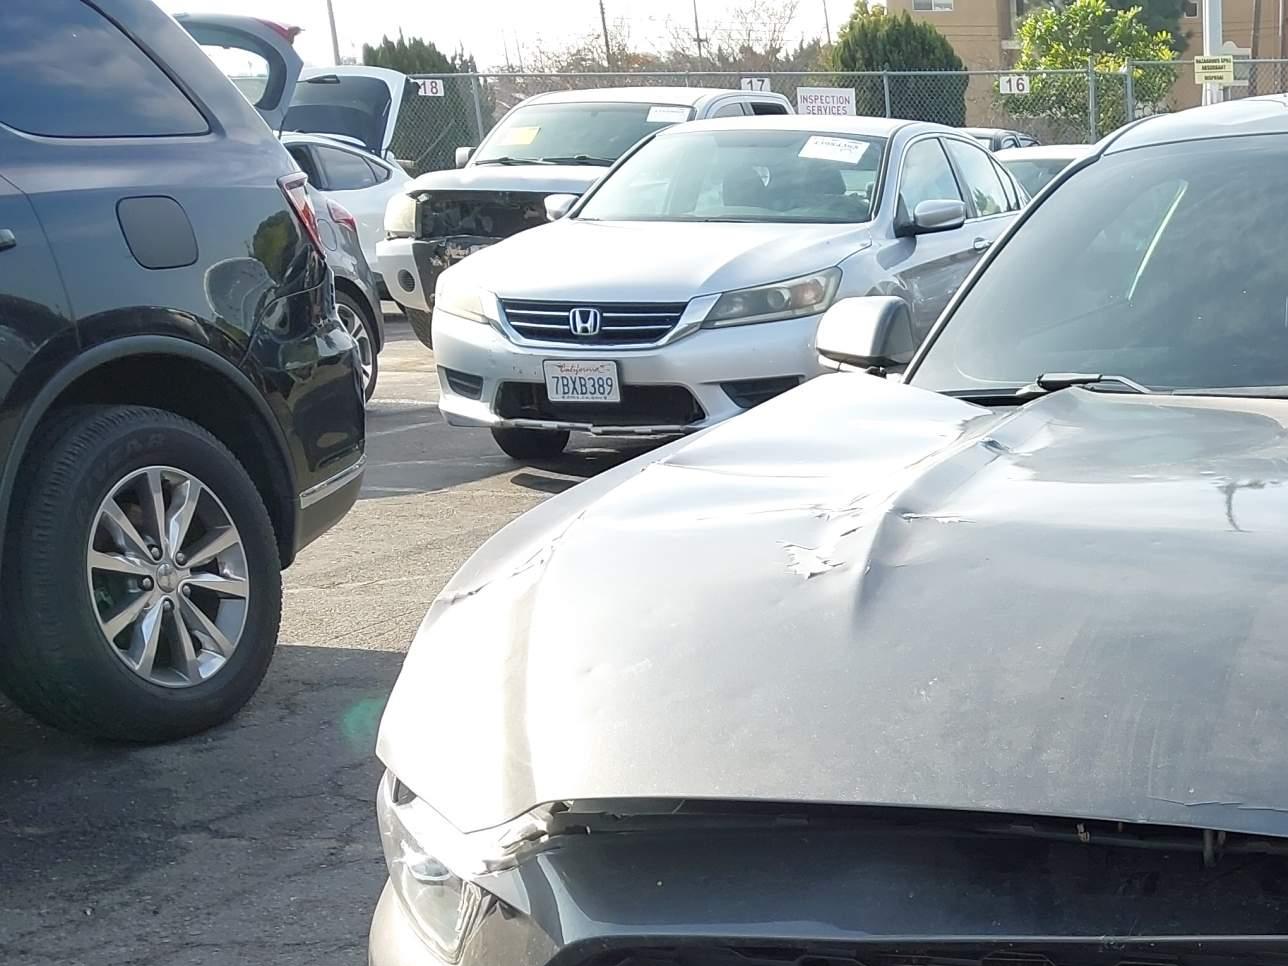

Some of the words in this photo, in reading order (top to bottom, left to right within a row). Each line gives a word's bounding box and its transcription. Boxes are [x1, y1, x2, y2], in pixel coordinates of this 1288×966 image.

[420, 80, 439, 95] 18
[746, 79, 766, 91] 17
[1006, 77, 1025, 92] 16
[800, 94, 850, 105] INSPECTION
[806, 105, 848, 115] SERVICES
[552, 376, 613, 396] 7BXB389
